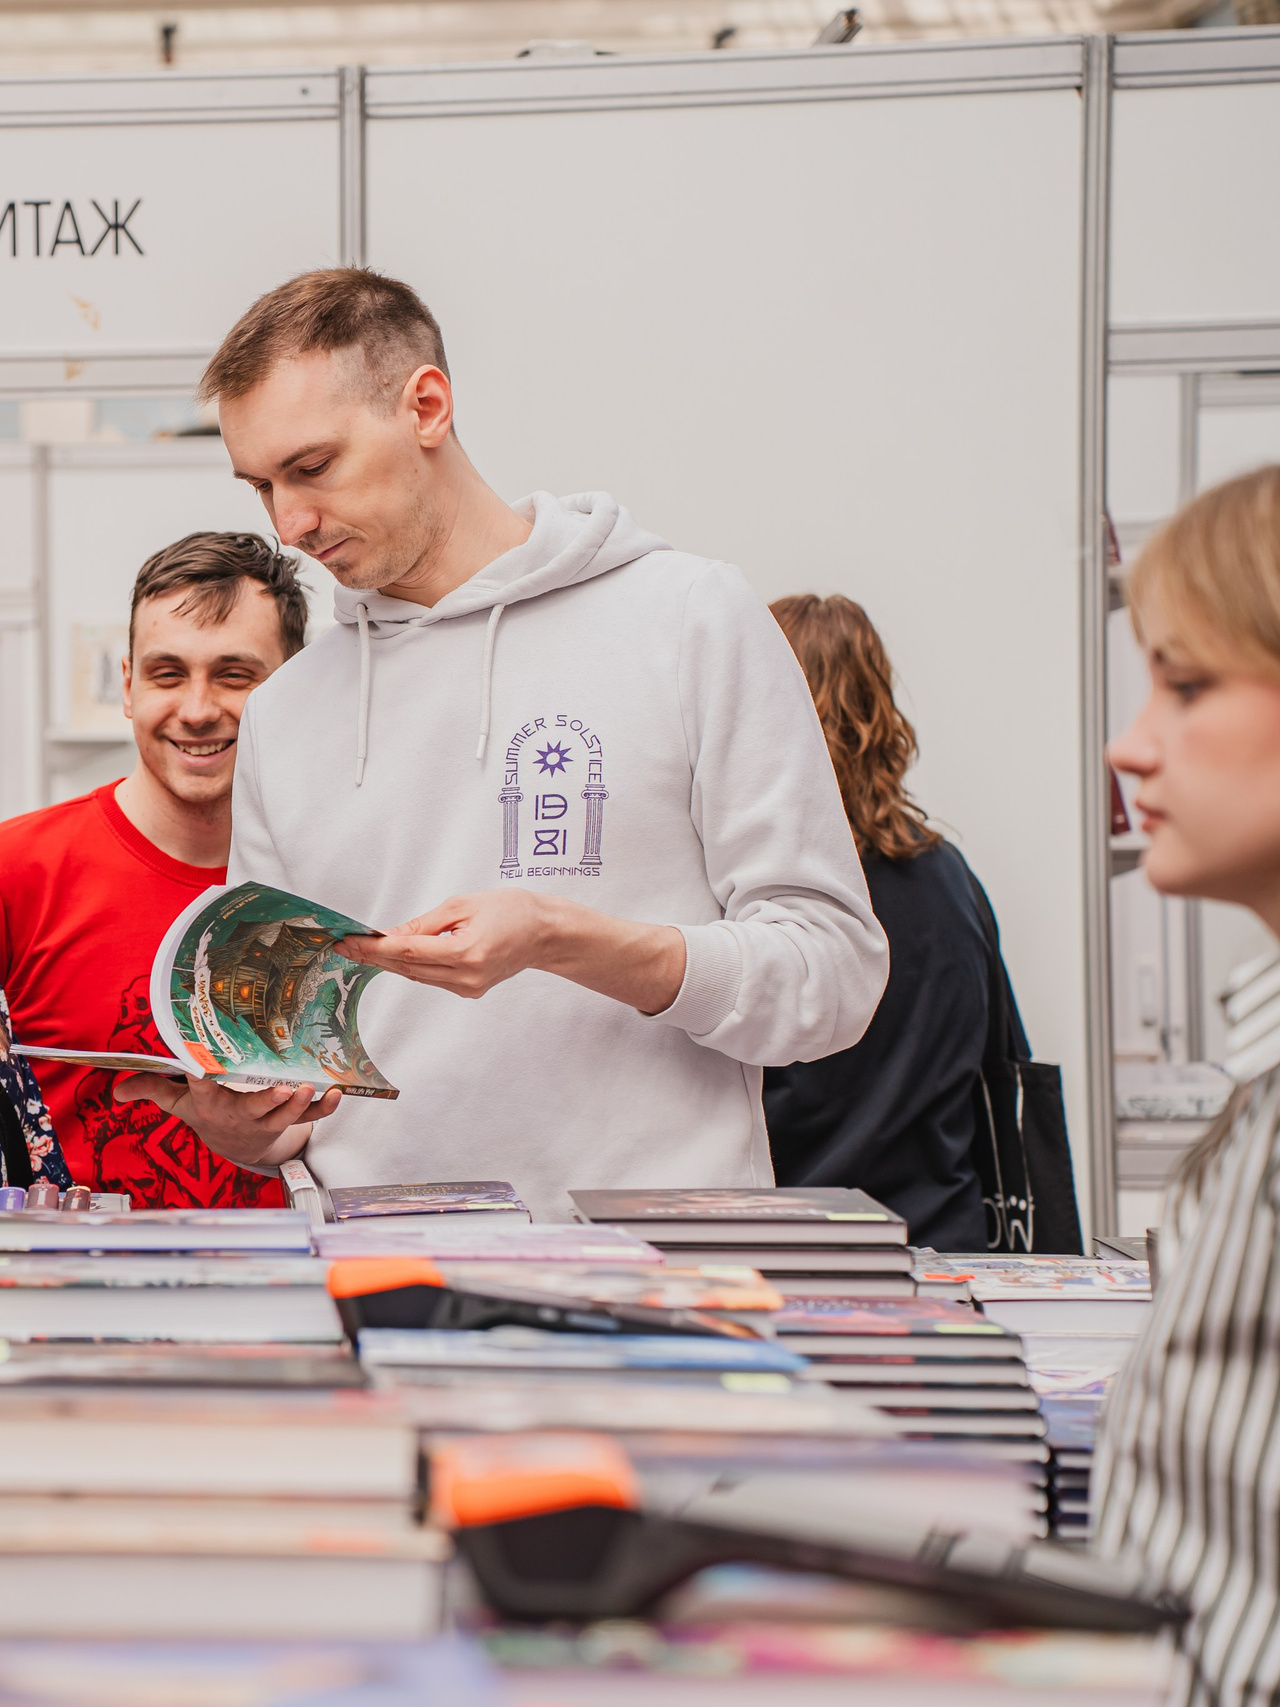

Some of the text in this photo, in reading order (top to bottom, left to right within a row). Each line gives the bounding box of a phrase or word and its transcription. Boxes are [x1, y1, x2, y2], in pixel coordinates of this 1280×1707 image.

[504, 714, 603, 785] SUMMER SOLSTICE
[500, 866, 600, 879] NEW BEGINNINGS
